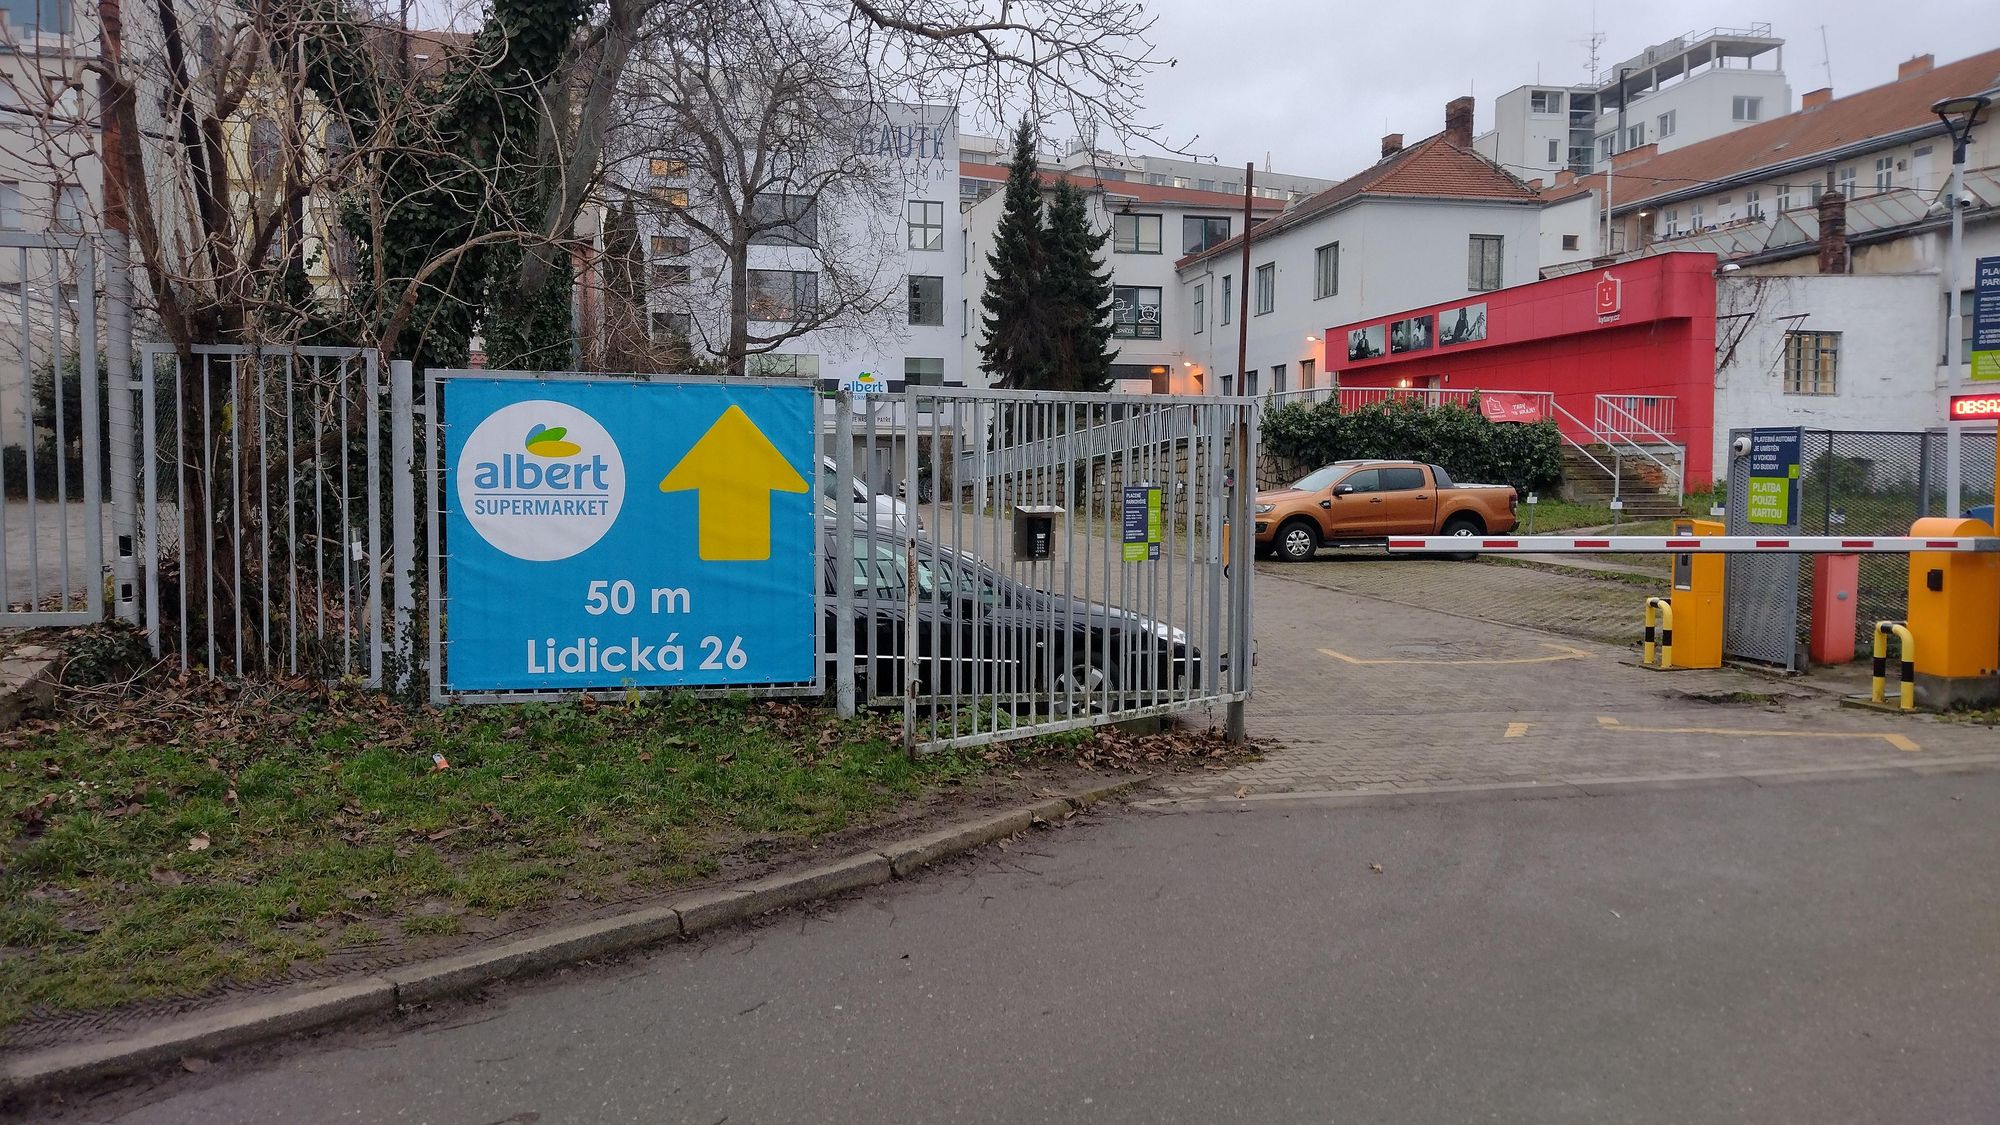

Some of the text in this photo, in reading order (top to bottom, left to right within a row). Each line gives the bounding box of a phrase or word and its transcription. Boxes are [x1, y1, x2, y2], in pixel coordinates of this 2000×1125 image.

[1982, 267, 2000, 276] PLA
[1981, 277, 2000, 287] PAR
[844, 380, 883, 393] albert
[474, 453, 609, 490] albert
[1752, 482, 1782, 493] PLATBA
[1752, 495, 1777, 506] POUZE
[474, 499, 609, 517] SUPERMARKET
[1751, 508, 1782, 518] KARTOU
[584, 579, 691, 616] 50 m
[527, 632, 748, 674] Lidická 26
